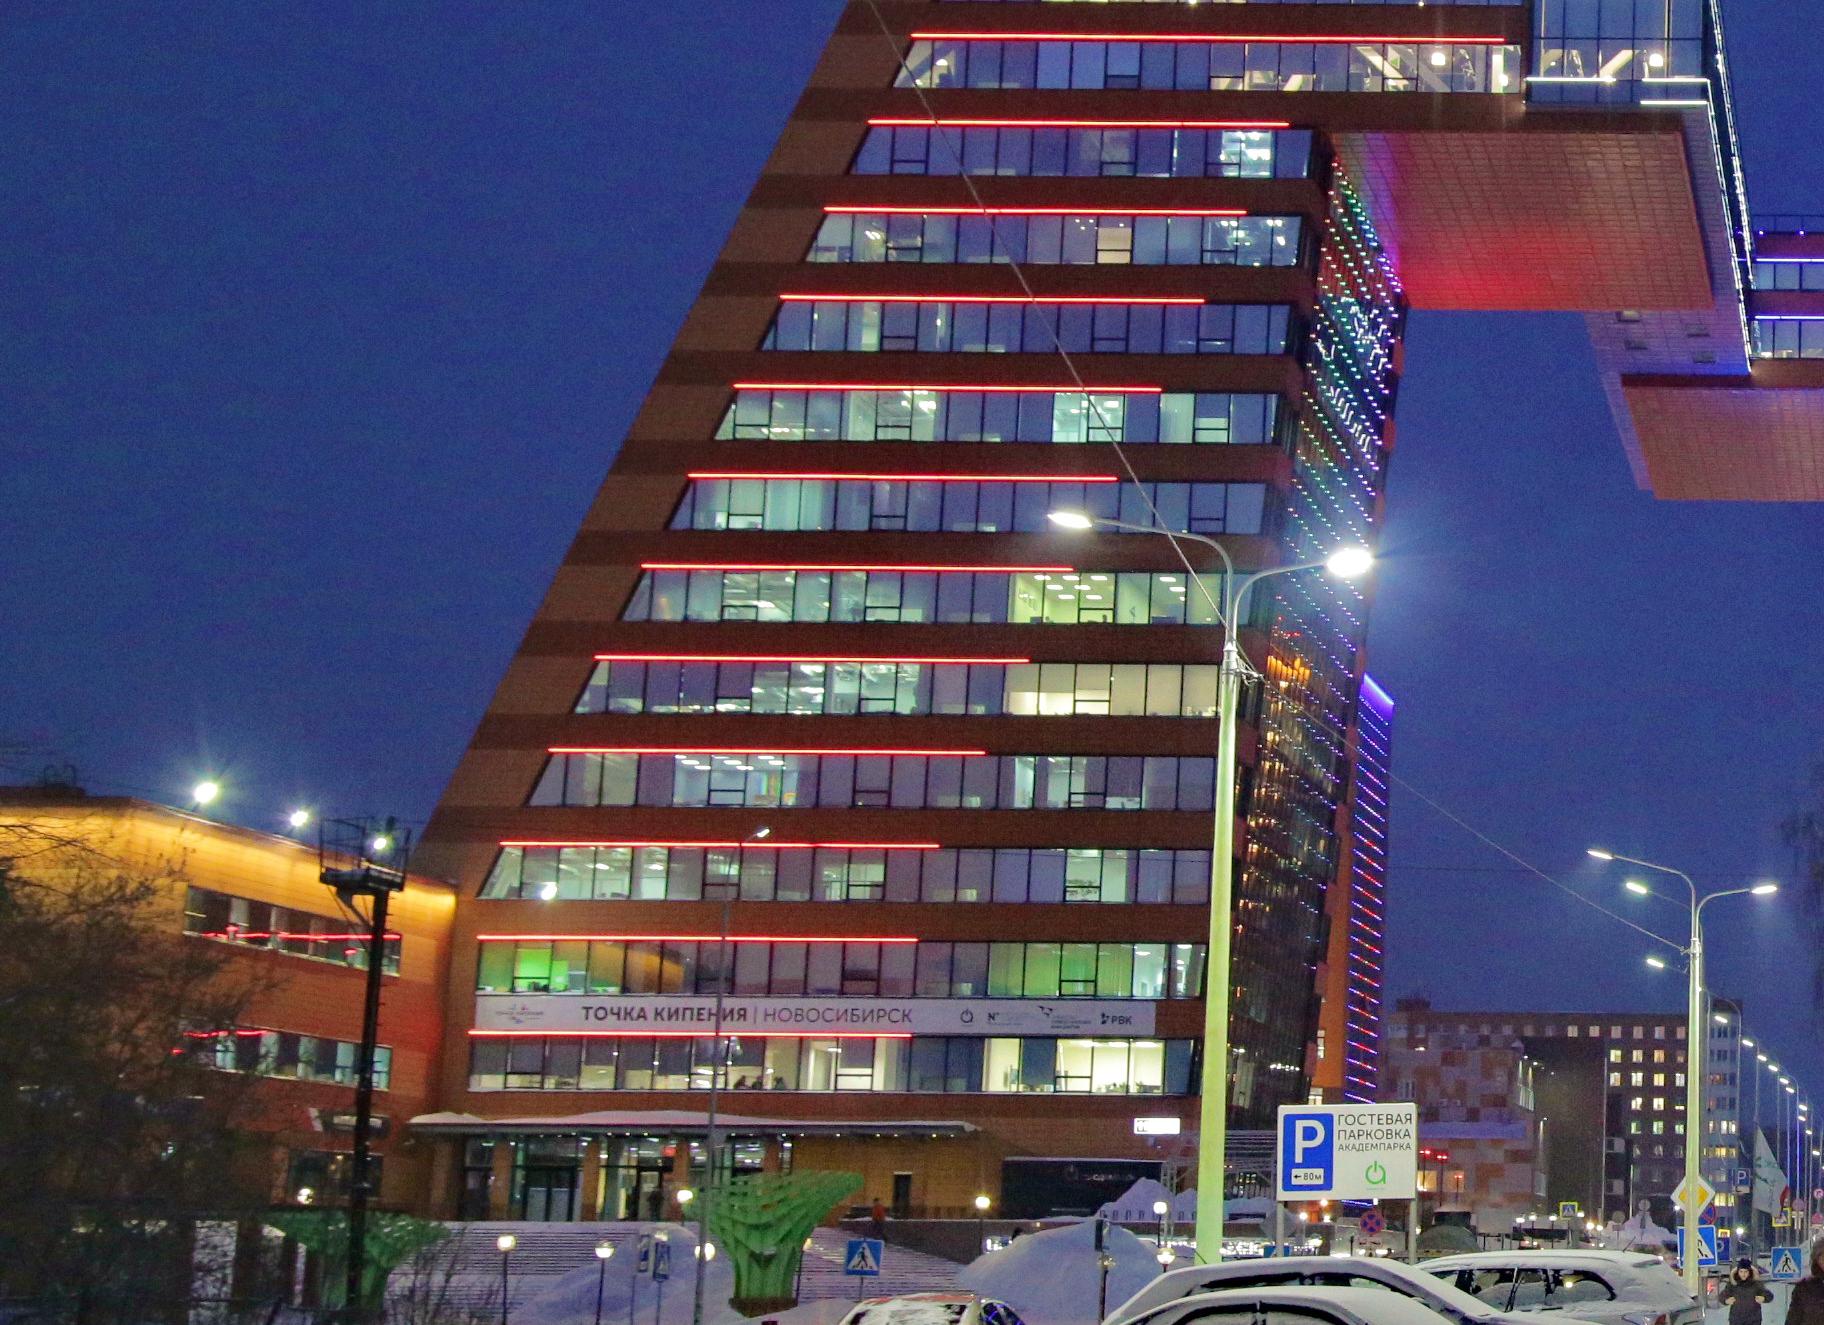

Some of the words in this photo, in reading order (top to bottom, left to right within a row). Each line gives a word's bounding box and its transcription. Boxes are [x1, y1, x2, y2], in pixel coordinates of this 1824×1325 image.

[581, 1006, 648, 1022] ТОЧКА
[654, 1006, 747, 1023] КИПЕНИЯ
[764, 1007, 913, 1024] НОВОСИБИРСК
[1338, 1113, 1412, 1126] ГОСТЕВАЯ
[1338, 1128, 1412, 1141] ПАРКОВКА
[1295, 1119, 1326, 1164] P
[1338, 1142, 1412, 1152] АКАДЕМПАРКА
